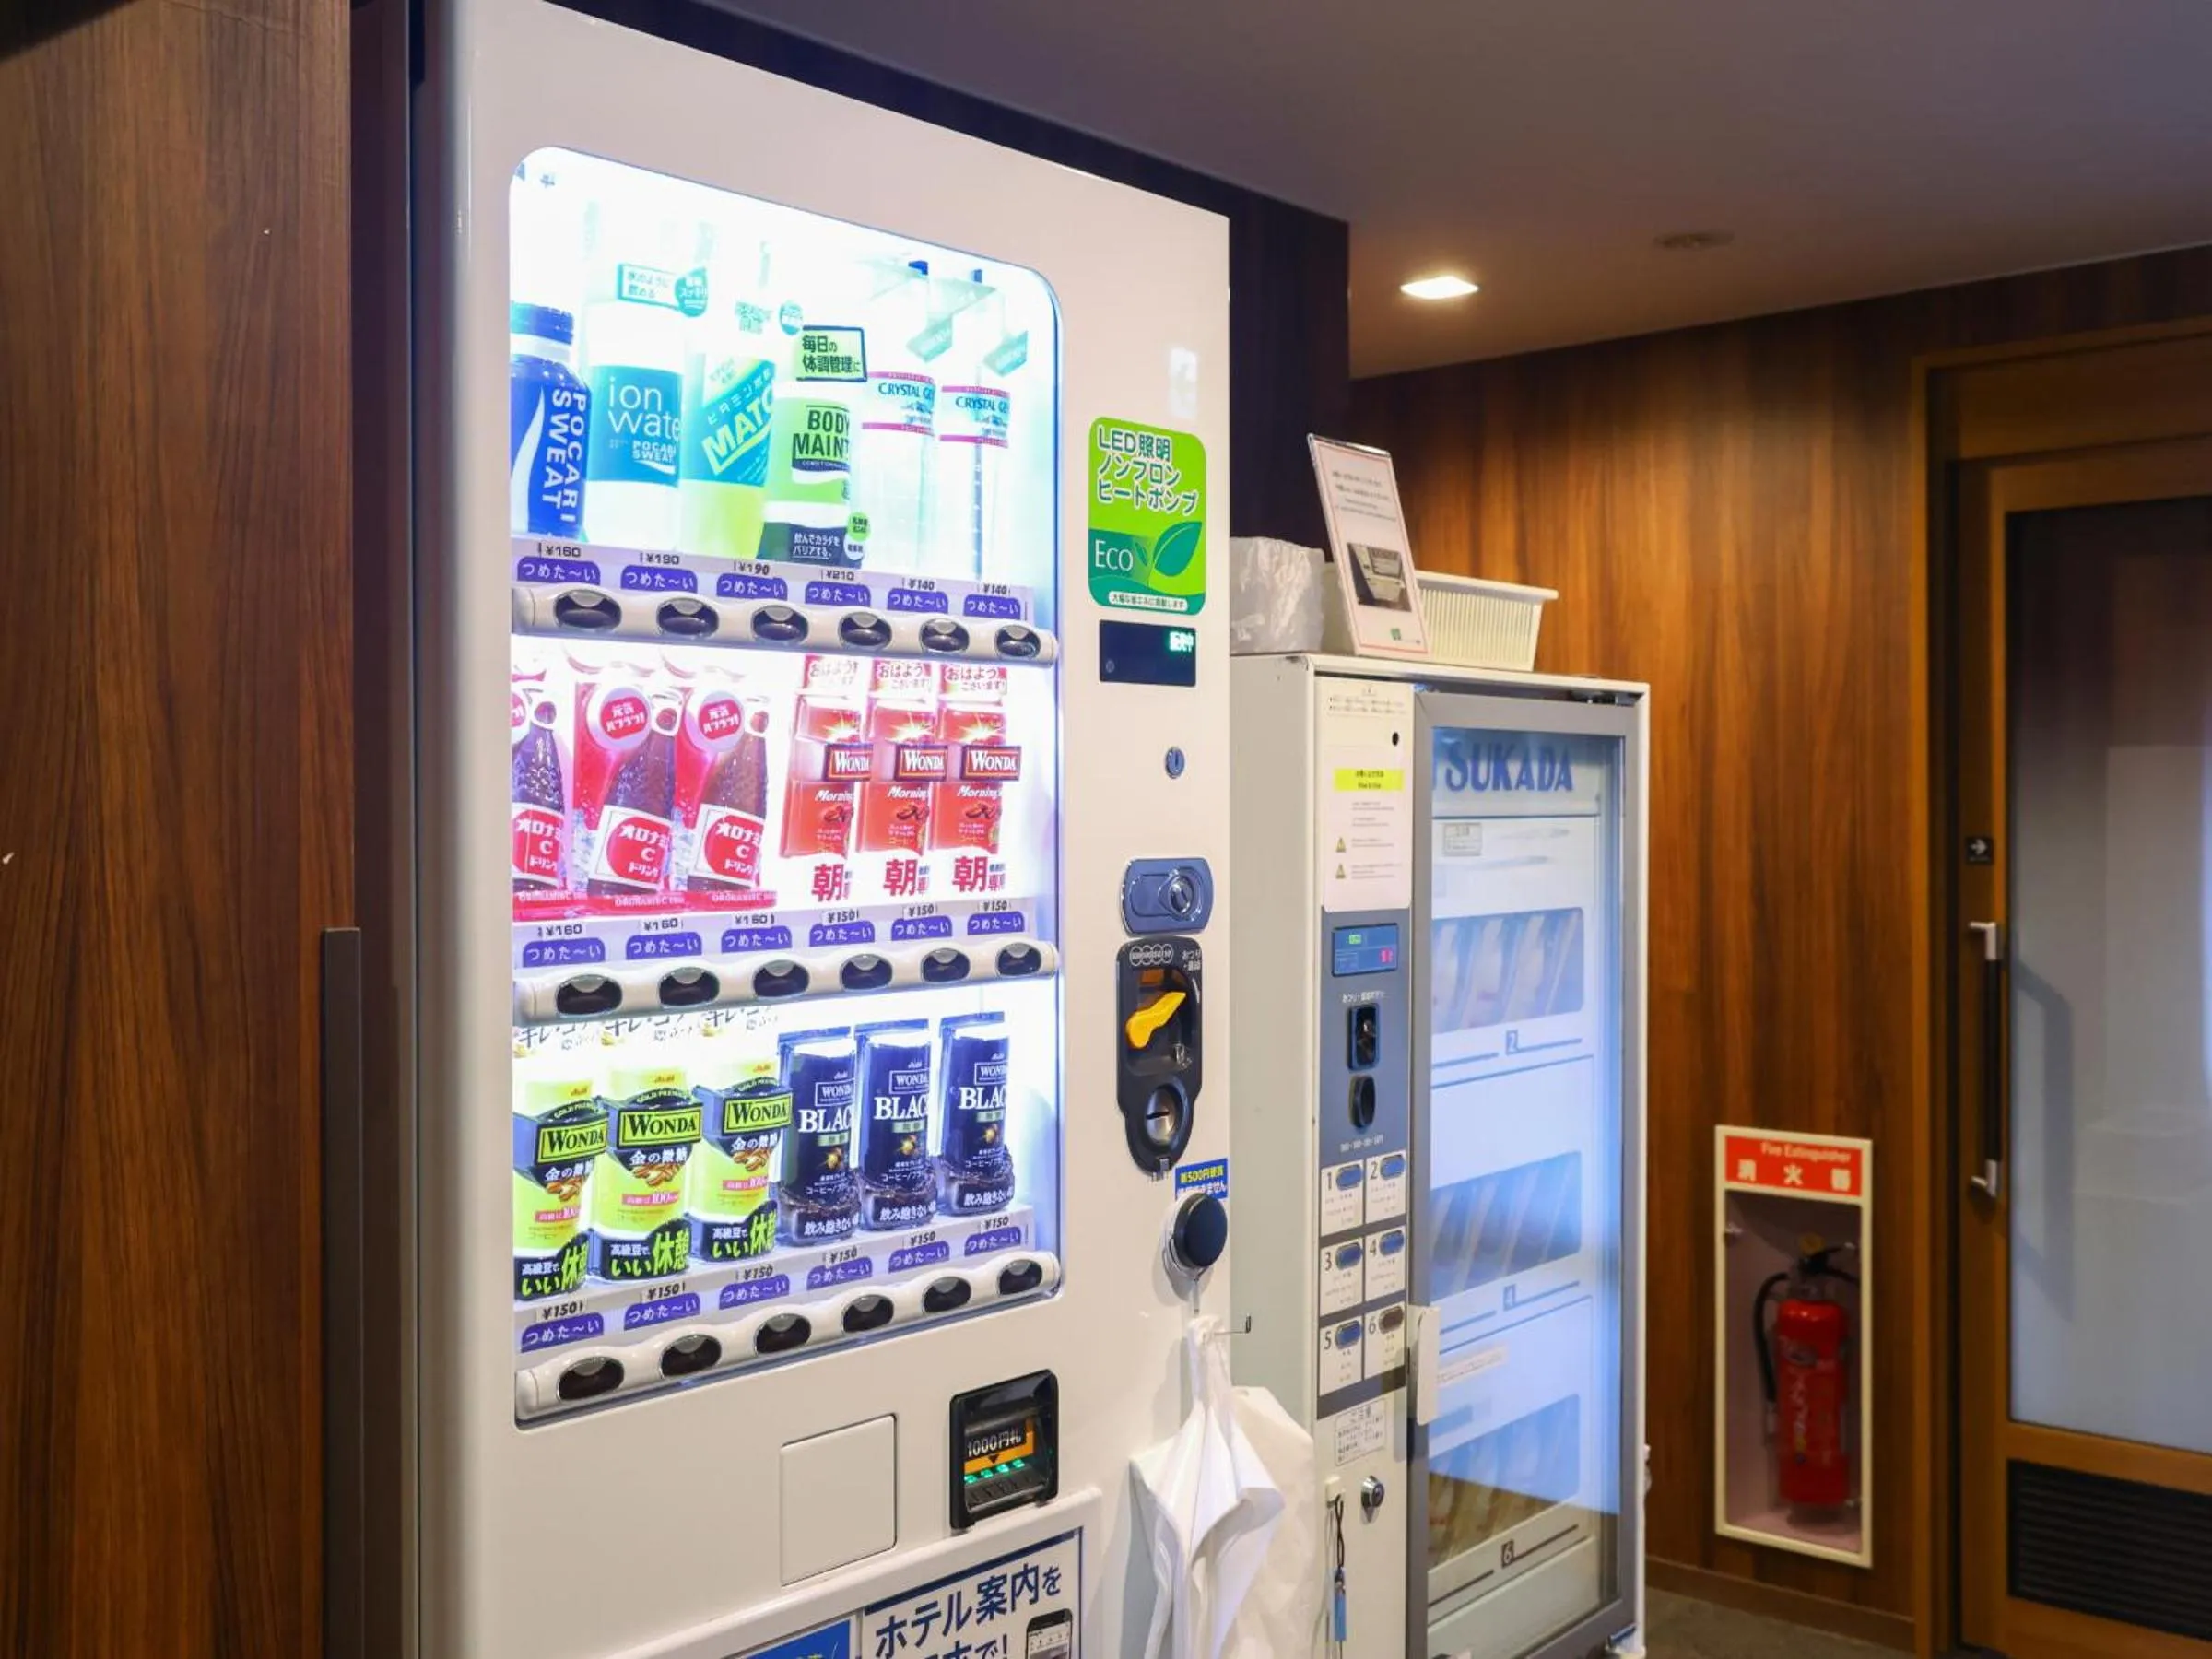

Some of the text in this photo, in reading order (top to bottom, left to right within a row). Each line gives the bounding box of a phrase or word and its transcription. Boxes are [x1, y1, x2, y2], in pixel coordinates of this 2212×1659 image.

[802, 335, 838, 354] 毎日の
[608, 376, 662, 412] ion
[878, 382, 920, 398] CRYSTAL
[955, 395, 995, 411] CRYSTAL
[542, 388, 571, 510] SWEAT
[1099, 426, 1171, 462] LED照明
[559, 393, 587, 523] POCARI
[1099, 454, 1180, 487] ノンフロン
[1099, 478, 1197, 514] ヒートポンプ
[546, 546, 582, 559] ¥160
[646, 553, 681, 566] ¥190
[738, 561, 771, 576] ¥190
[903, 749, 945, 771] WONDA
[970, 749, 1017, 771] WONDA
[1432, 740, 1574, 792] SUKADA
[539, 840, 553, 855] C
[641, 847, 656, 862] C
[735, 846, 751, 859] C
[909, 904, 935, 917] ¥150
[983, 900, 1007, 912] ¥150
[644, 918, 678, 931] ¥160
[735, 914, 769, 925] ¥160
[829, 912, 855, 924] ¥150
[547, 924, 582, 936] ¥160
[734, 1096, 789, 1124] WONDA
[624, 1111, 697, 1137] WONDA
[547, 1124, 604, 1153] WONDA
[1370, 1162, 1379, 1181] 2
[1326, 1171, 1334, 1191] 1
[984, 1216, 1009, 1229] ¥150
[910, 1231, 936, 1244] ¥150
[830, 1248, 858, 1263] ¥150
[1369, 1239, 1377, 1257] 4
[1324, 1252, 1333, 1271] 3
[743, 1267, 773, 1281] ¥150
[647, 1284, 680, 1300] ¥150
[542, 1302, 578, 1319] ¥150
[1368, 1317, 1376, 1335] 6
[1324, 1331, 1332, 1350] 5
[968, 1428, 1022, 1457] 1000円札
[875, 1563, 1062, 1659] ホテル案内を
